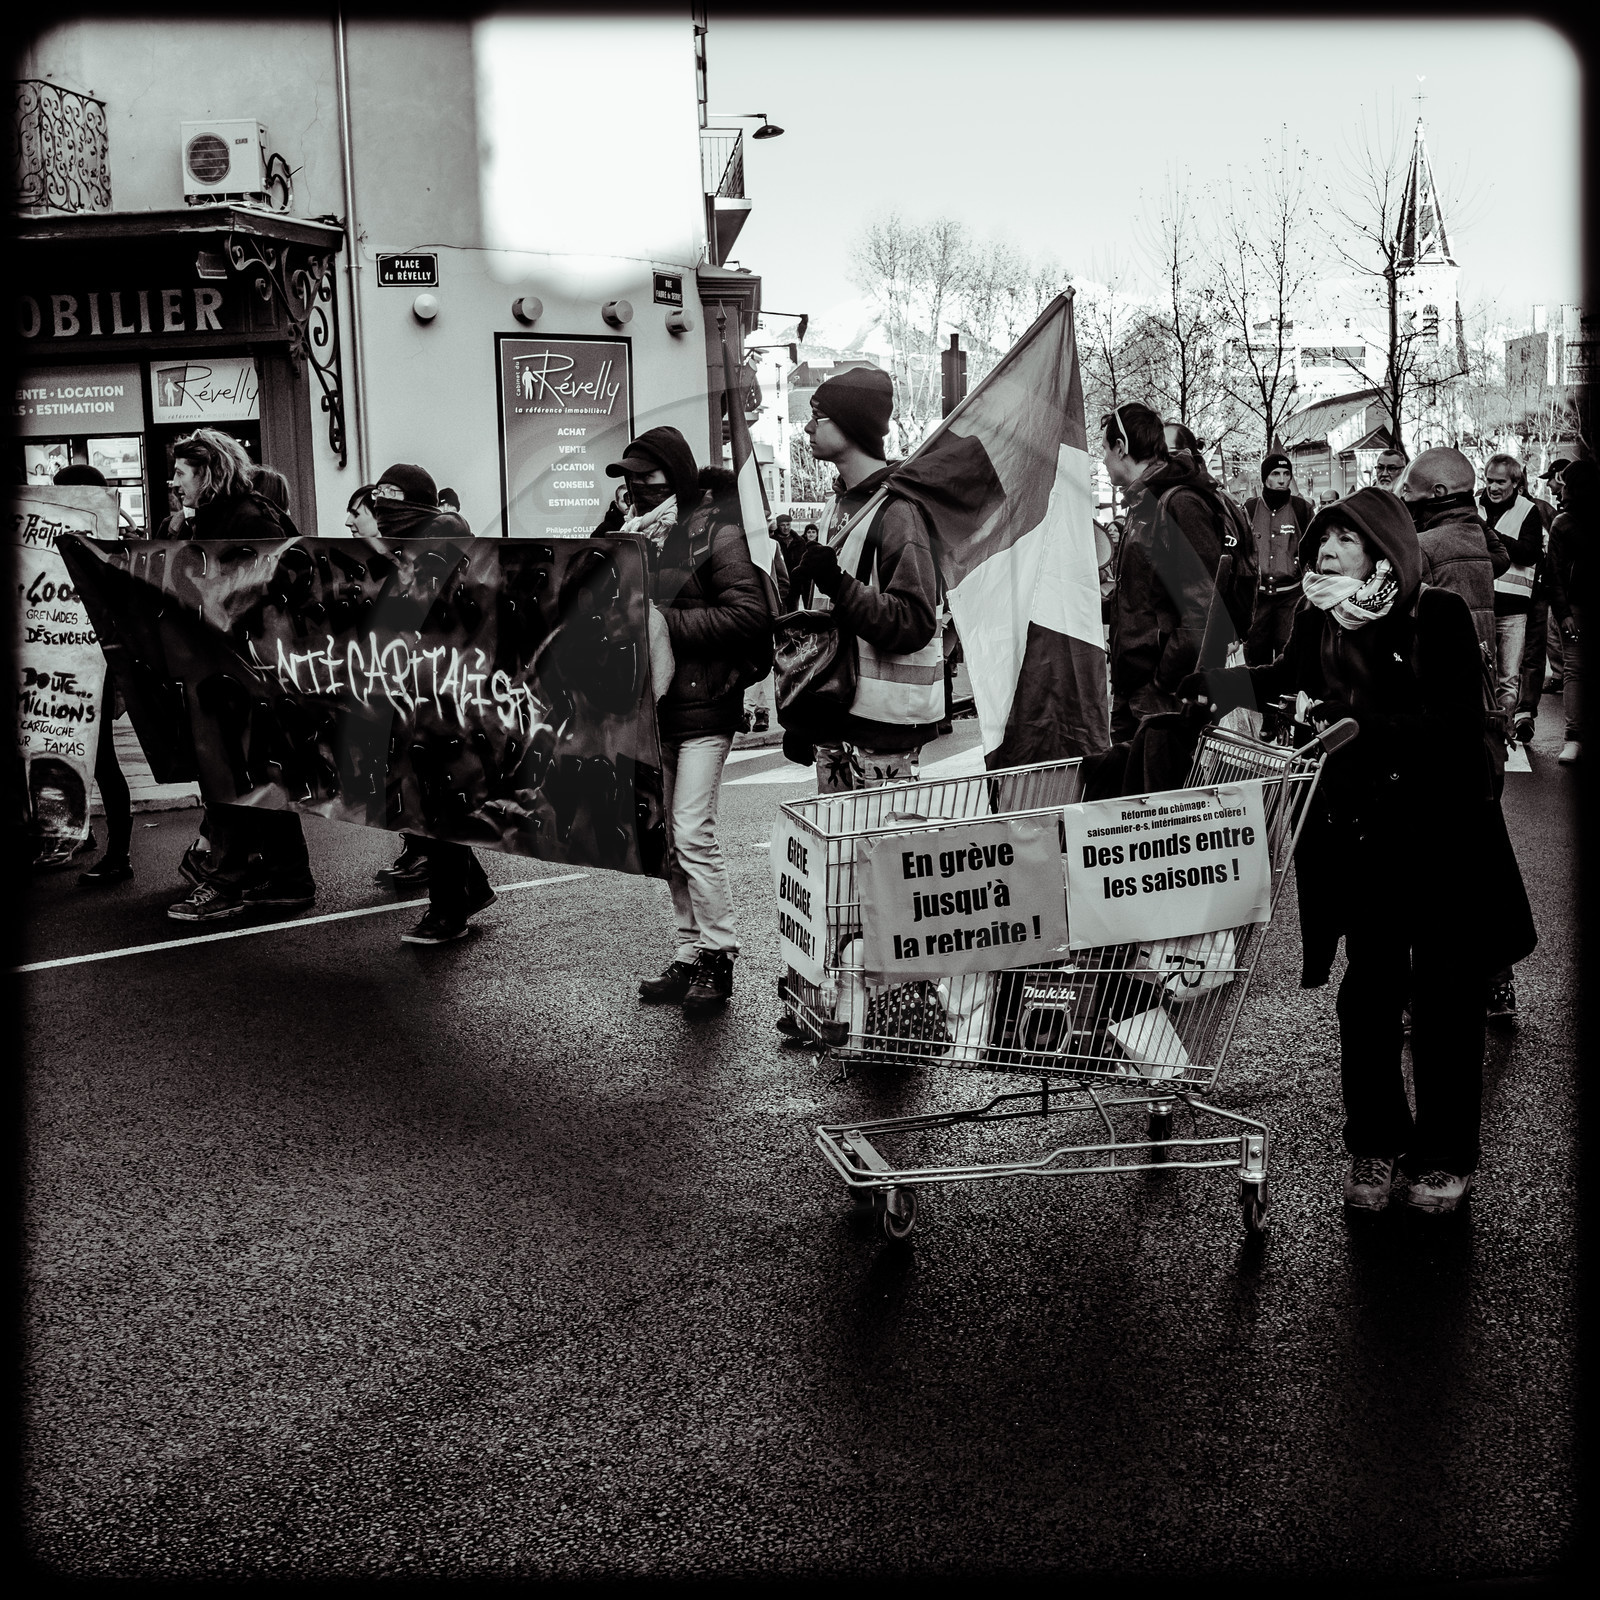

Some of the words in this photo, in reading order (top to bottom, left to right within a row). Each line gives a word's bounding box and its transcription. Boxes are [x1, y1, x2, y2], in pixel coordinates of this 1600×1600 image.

[395, 259, 420, 269] PLACE
[384, 271, 393, 281] du
[397, 270, 431, 281] RÉVELLY
[515, 361, 520, 369] du
[157, 361, 259, 417] Révelly
[512, 349, 620, 415] Révelly
[57, 385, 124, 399] LOCATION
[36, 401, 115, 416] ESTIMATION
[525, 406, 562, 414] référence
[557, 428, 586, 436] ACHAT
[559, 445, 586, 454] VENTE
[551, 463, 595, 471] LOCATION
[553, 481, 594, 489] CONSEILS
[548, 498, 600, 507] ESTIMATION
[26, 609, 78, 625] GRENADES
[21, 720, 75, 737] CARTOUCHE
[43, 738, 85, 756] FAMAS
[1121, 809, 1157, 821] Réforme
[1158, 806, 1169, 815] du
[1170, 801, 1206, 814] chômage
[1151, 814, 1202, 830] intérimaires
[1202, 812, 1213, 821] en
[1214, 808, 1241, 819] colère
[1082, 845, 1124, 868] Des
[1129, 832, 1190, 862] ronds
[1196, 826, 1255, 852] entre
[901, 851, 934, 880] En
[939, 842, 1014, 879] grève
[1103, 876, 1137, 899] les
[1141, 863, 1228, 894] saisons
[1232, 858, 1240, 881] !
[912, 879, 1010, 922] jusqu'à
[893, 934, 920, 960] la
[925, 921, 1027, 956] retraite
[1032, 915, 1041, 940] !
